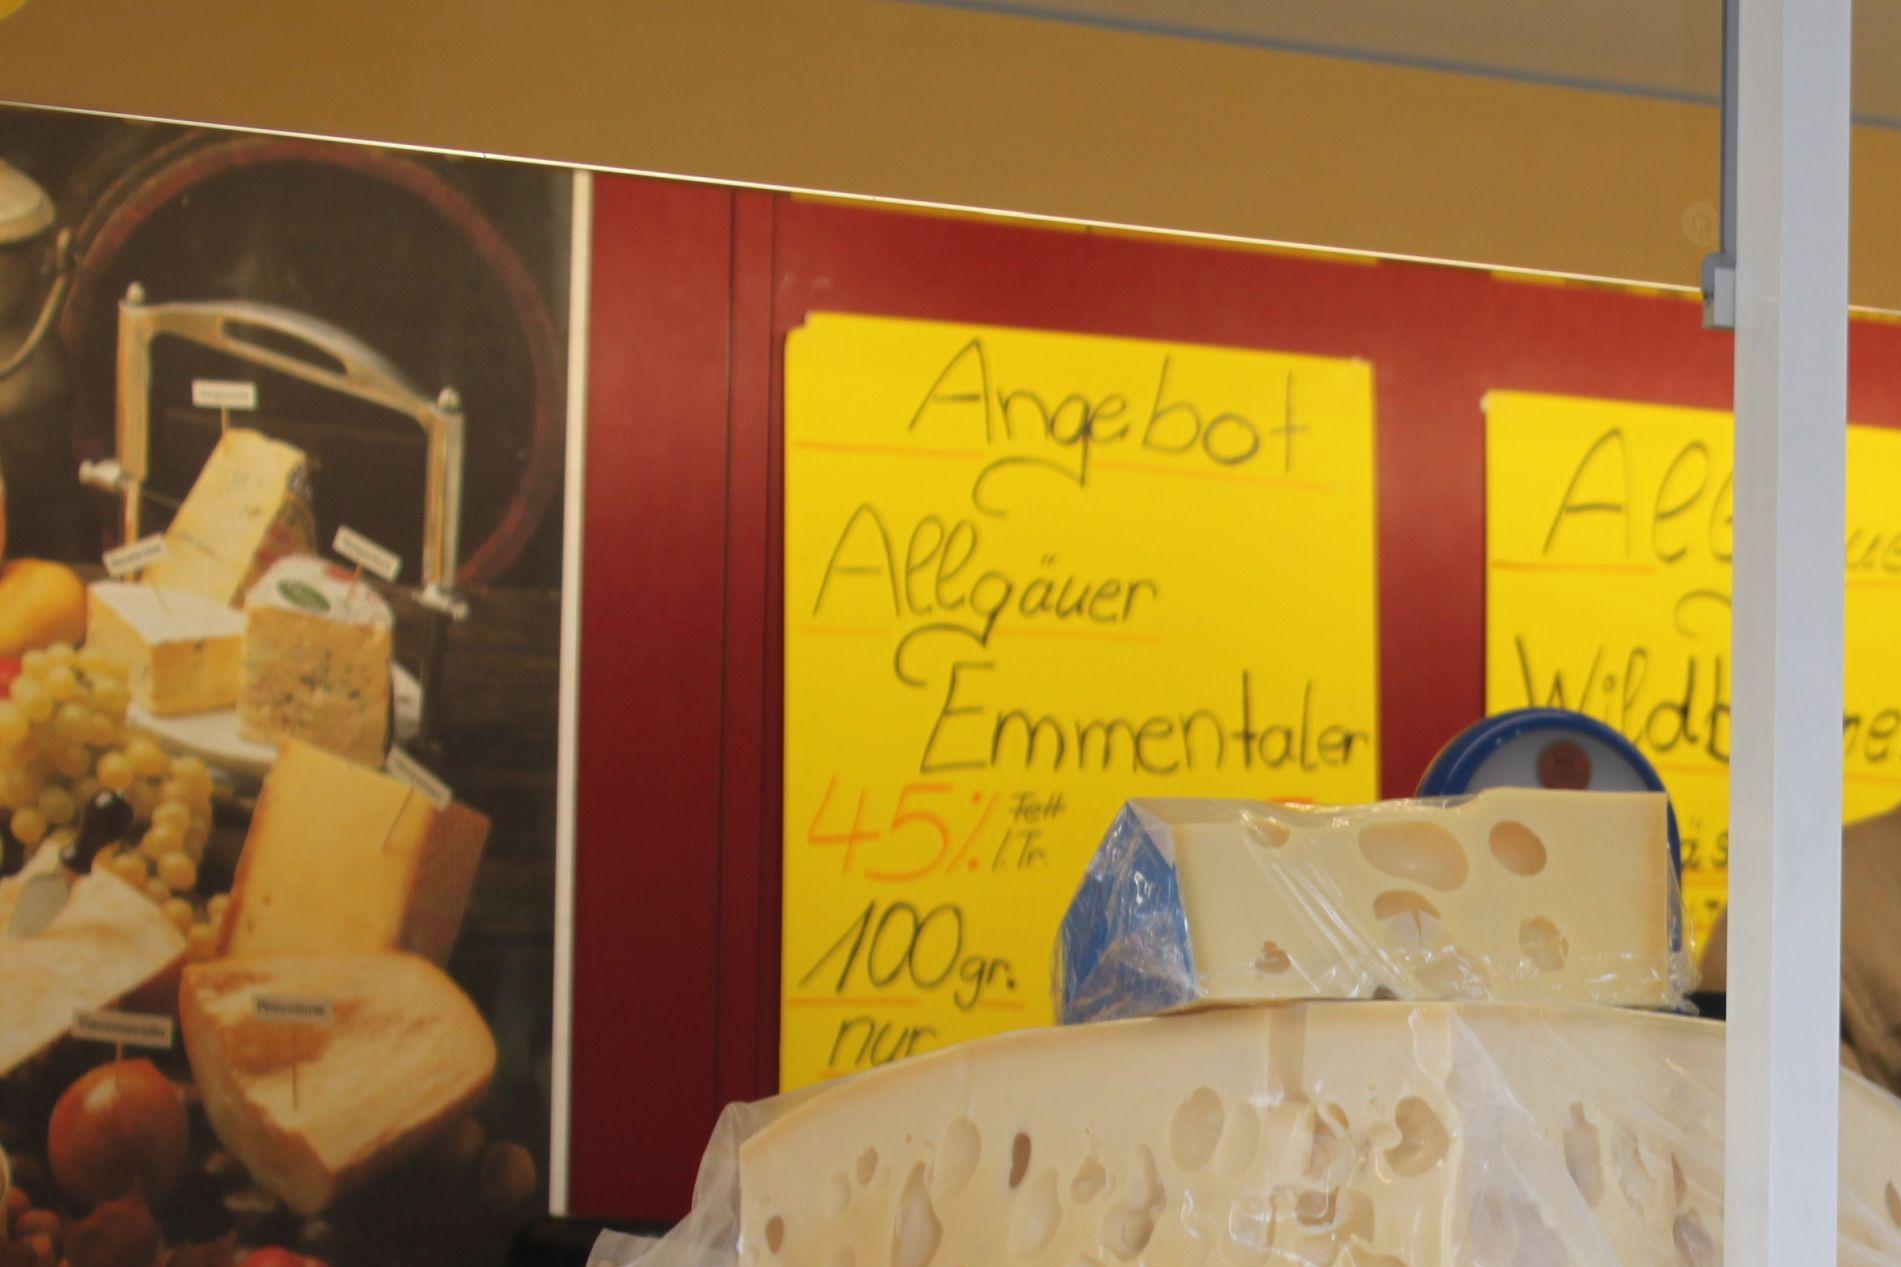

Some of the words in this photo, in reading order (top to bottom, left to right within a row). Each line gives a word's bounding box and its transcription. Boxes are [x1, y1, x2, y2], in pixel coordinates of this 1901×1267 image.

[907, 337, 1311, 517] Angebot
[812, 502, 1158, 688] Allgäuer
[919, 658, 1371, 776] Emmentaler
[827, 1013, 938, 1069] nur
